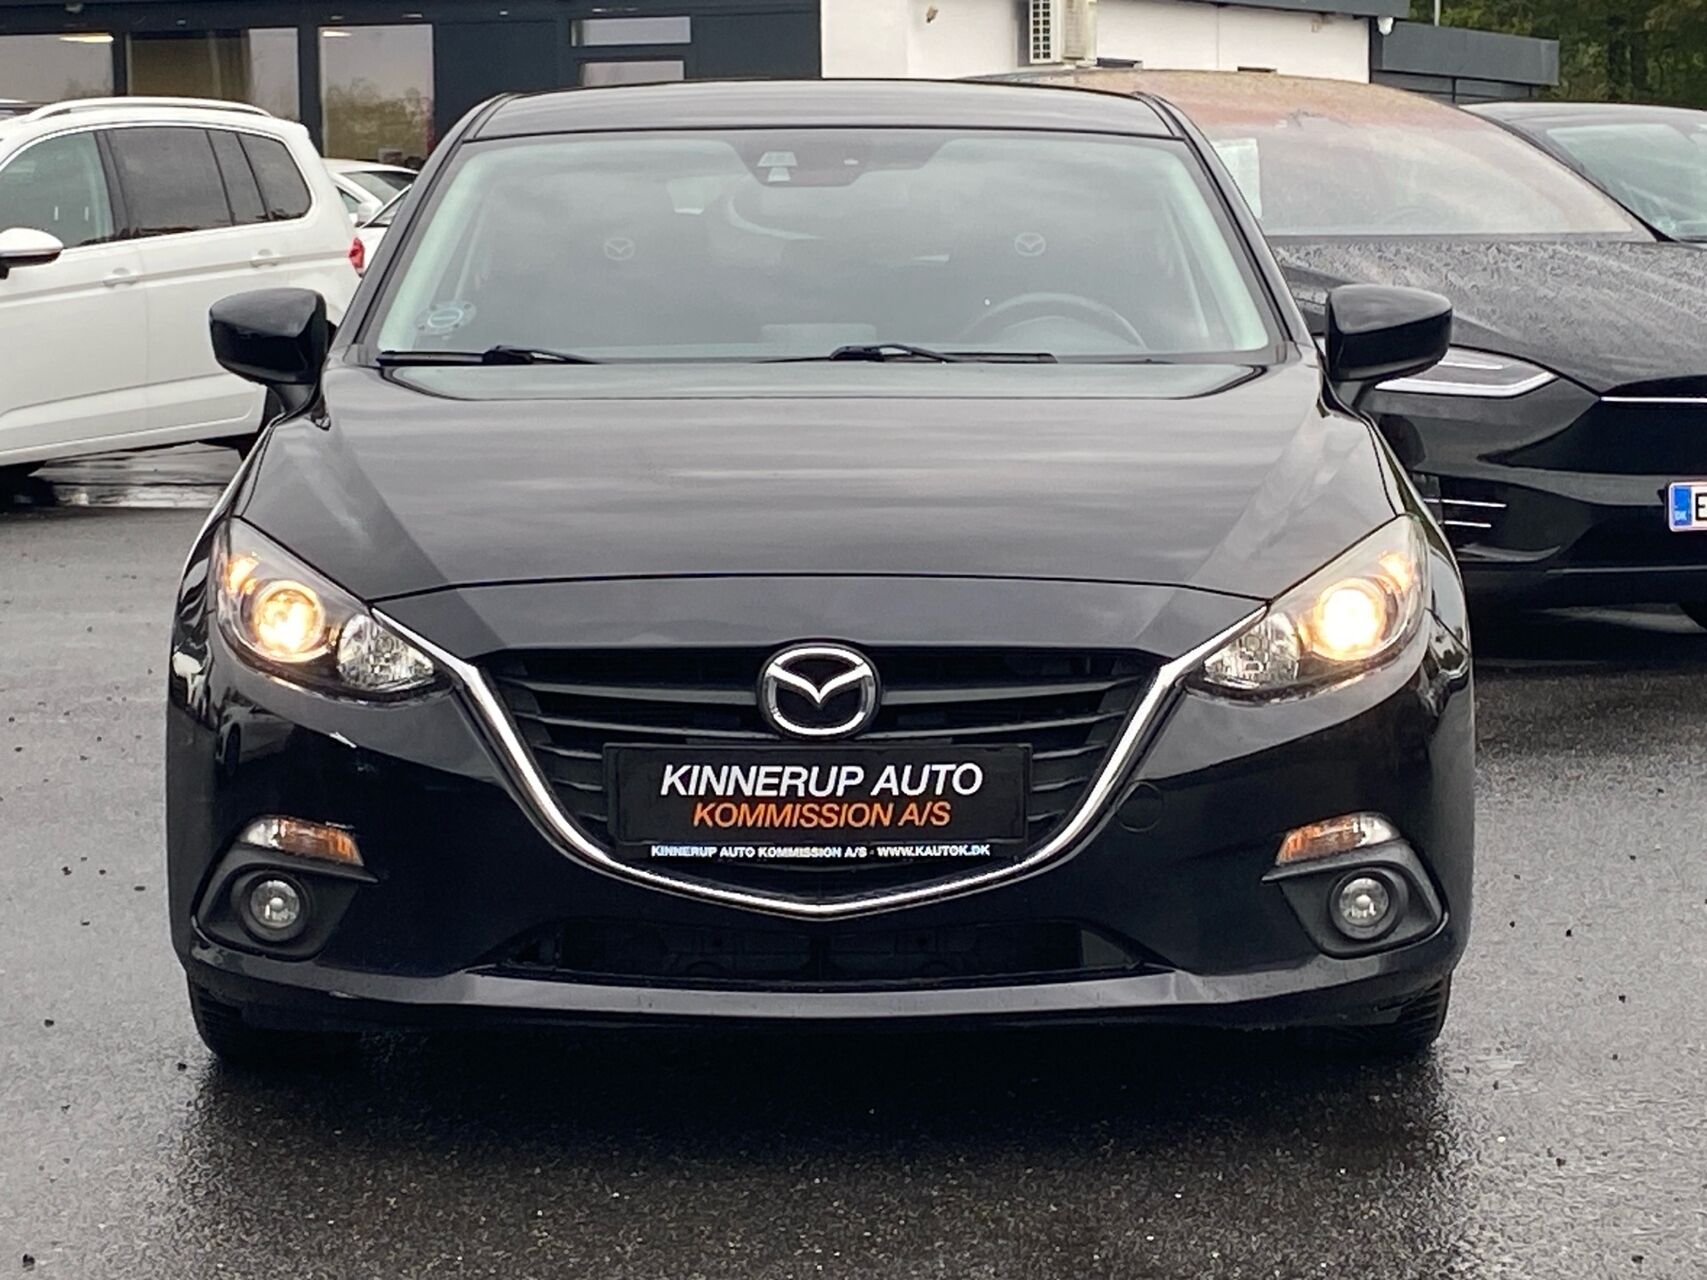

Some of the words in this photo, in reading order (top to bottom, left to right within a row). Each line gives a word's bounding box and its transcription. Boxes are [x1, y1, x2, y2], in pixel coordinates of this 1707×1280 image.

[660, 764, 864, 797] KINNERUP
[870, 762, 983, 796] AUTO
[693, 802, 894, 828] KOMMISSION
[897, 801, 951, 827] A/S
[651, 845, 717, 857] KINNERUP
[719, 846, 756, 858] AUTO
[758, 846, 842, 858] KOMMISSION
[844, 846, 868, 858] A/S
[876, 844, 990, 858] WWW.KAUTOK.DK
